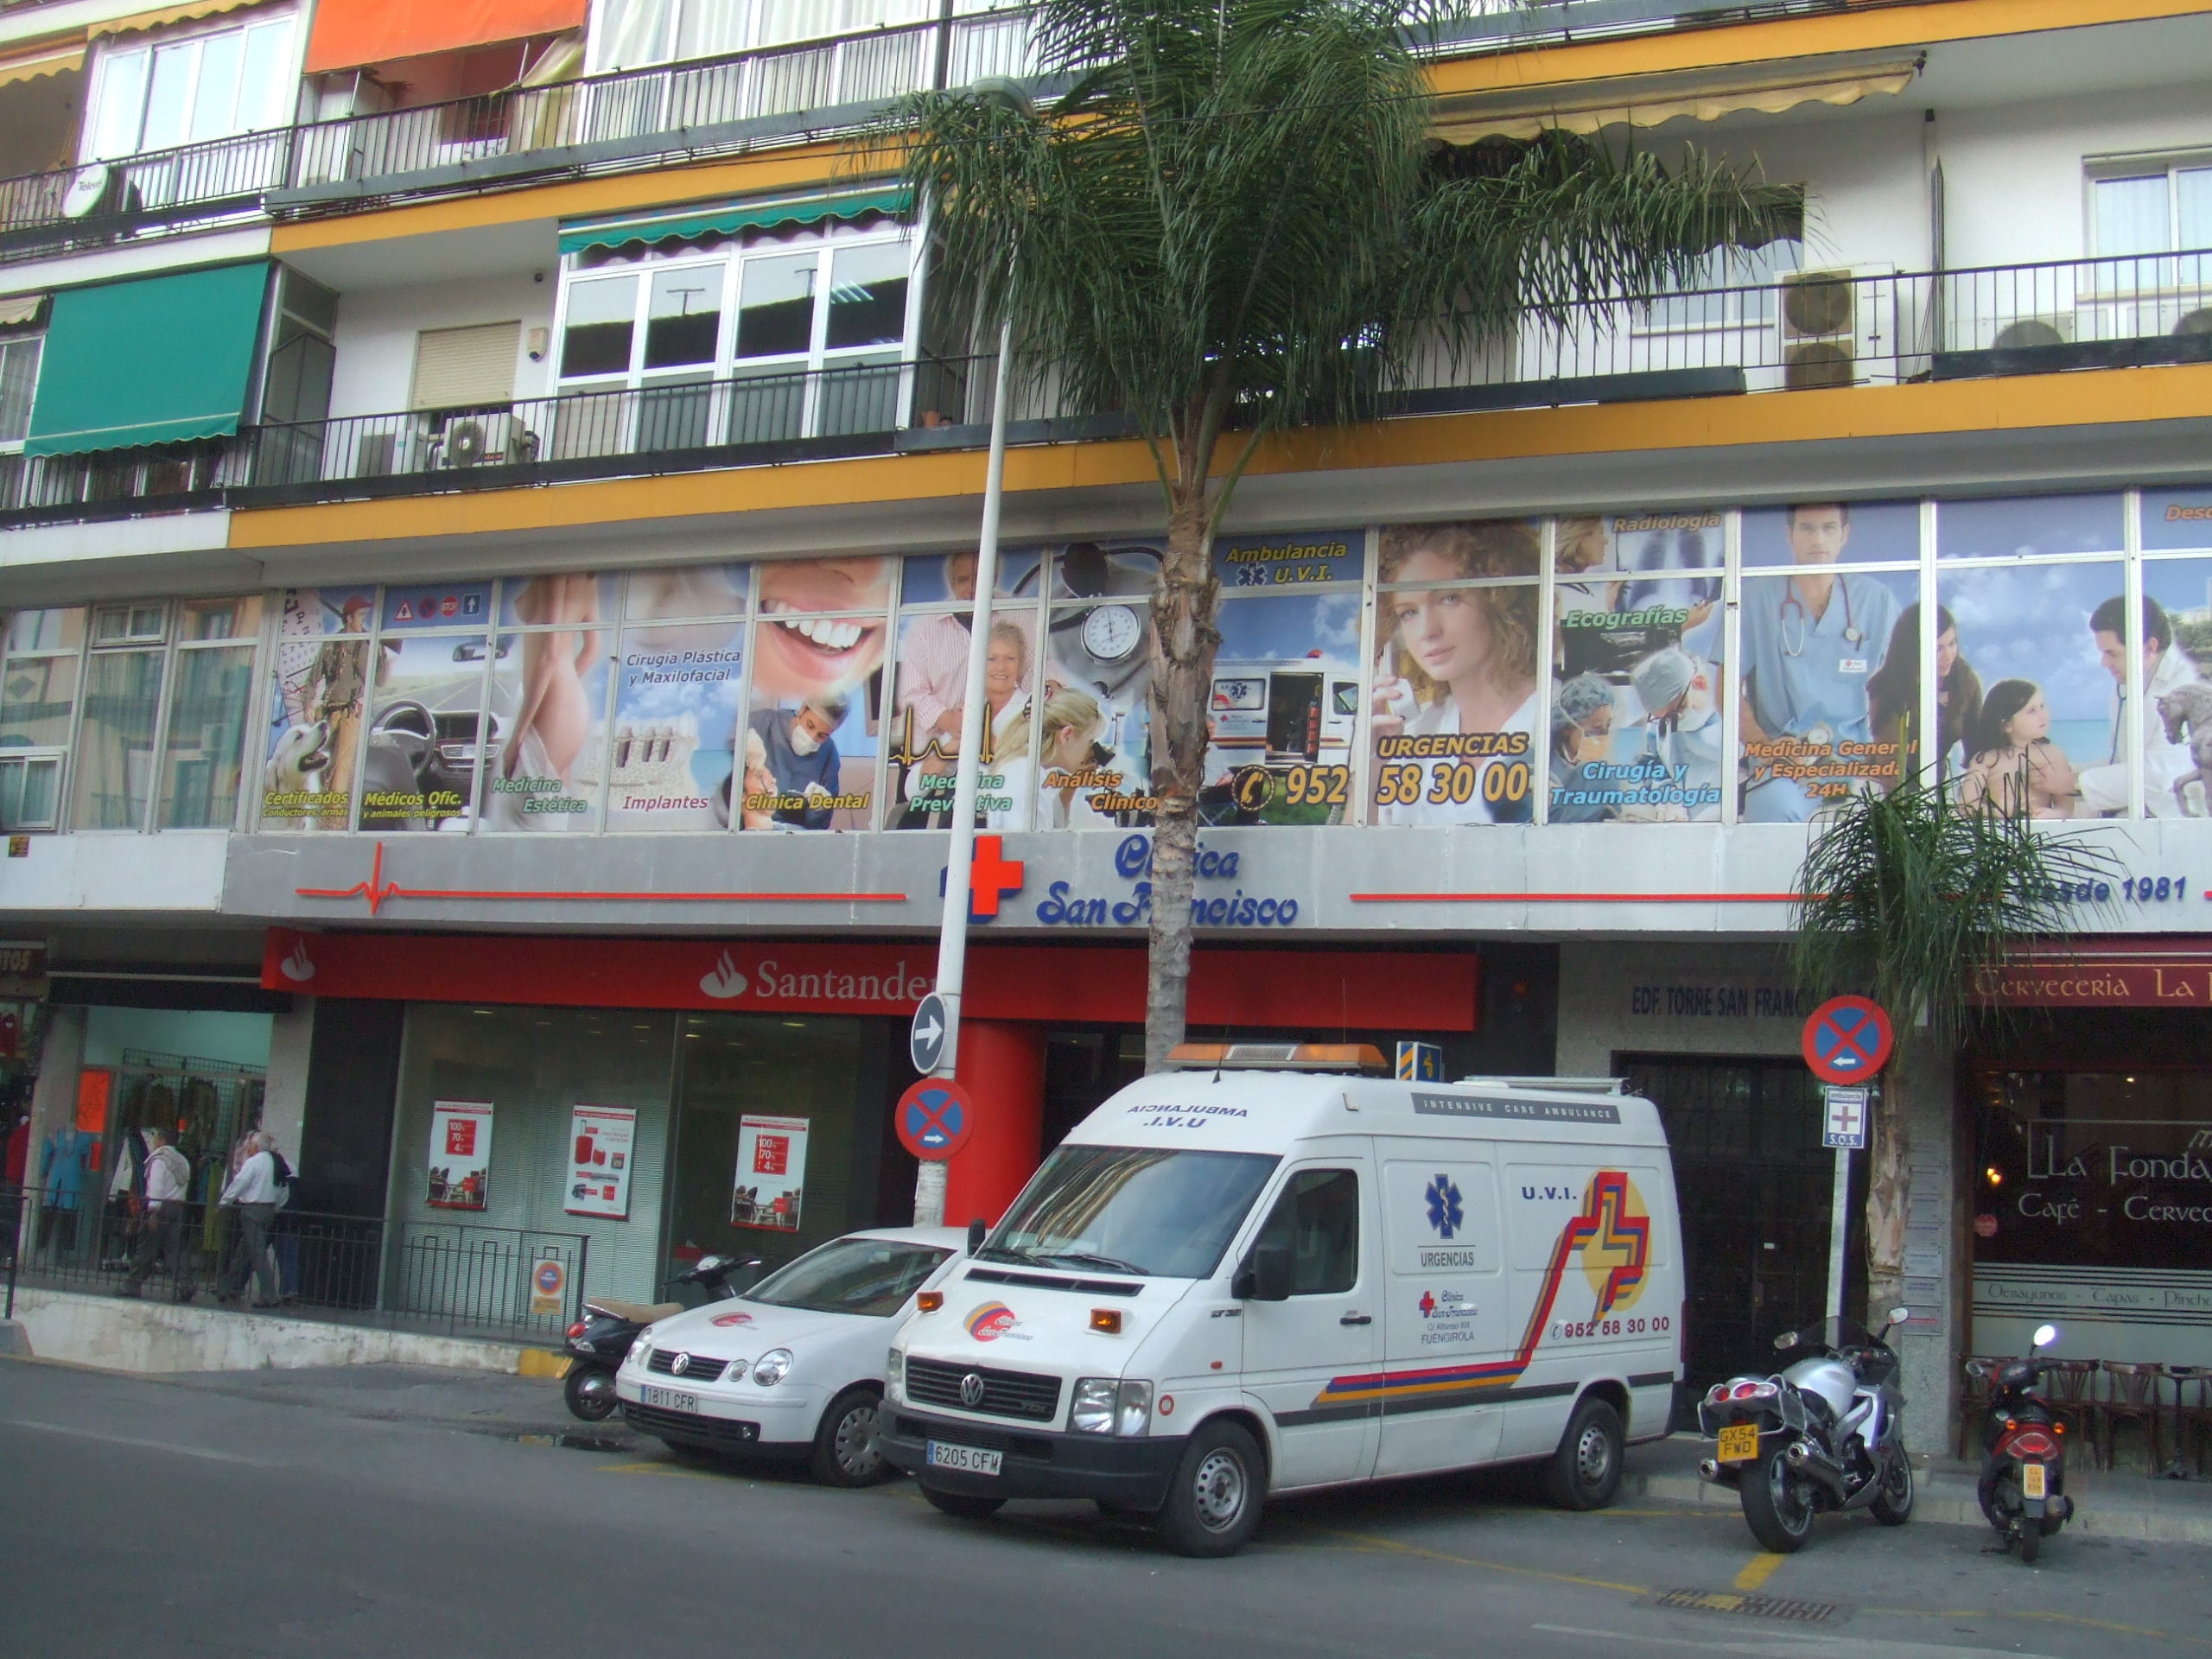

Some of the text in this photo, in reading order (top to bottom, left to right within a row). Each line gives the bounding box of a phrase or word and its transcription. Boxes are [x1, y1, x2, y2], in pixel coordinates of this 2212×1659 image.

[1612, 512, 1721, 532] Radiología
[1224, 542, 1347, 563] Ambulancia
[1274, 566, 1332, 583] U.V.I.
[1566, 605, 1688, 630] Ecografías
[683, 650, 741, 664] Plástica
[629, 669, 731, 687] y Maxilofacial
[1379, 734, 1529, 757] URGENCIAS
[1745, 739, 1918, 757] Medicina Generl
[1043, 770, 1122, 788] Análisis
[1582, 760, 1688, 782] Cirugía y
[1753, 766, 1765, 780] y
[492, 777, 563, 792] Medicina
[919, 772, 1005, 790] Medina
[1286, 762, 1529, 805] 952 58 30 00
[264, 791, 348, 805] Certificados
[364, 790, 462, 806] Médicos Ofic.
[1551, 783, 1720, 806] Traumatología
[1805, 783, 1848, 798] 24H
[523, 794, 588, 814] Estética
[622, 796, 709, 811] Implantes
[745, 792, 869, 810] Clínica Dental
[909, 795, 1014, 812] Prevtiva
[321, 808, 347, 817] armas
[371, 810, 410, 818] animales
[413, 808, 461, 819] peligrosos
[2122, 876, 2186, 902] 1981
[1037, 881, 1298, 925] San Fncisco
[756, 961, 938, 1001] Santande
[2154, 969, 2195, 996] La
[1667, 986, 1712, 1015] TORRE
[1717, 987, 1747, 1015] SAN
[1424, 1100, 1611, 1119] INTENSIVE CARE AMBULANCE
[1829, 1134, 1857, 1146] S.O.S.
[2046, 1135, 2212, 1185] La Fonda
[1522, 1186, 1577, 1200] U.V.I.
[1421, 1252, 1474, 1267] URGENCIAS
[1565, 1317, 1669, 1338] 952 58 30 00
[1421, 1332, 1474, 1344] FUENGIROLA
[648, 1389, 695, 1412] 1811 CFR
[1720, 1427, 1755, 1442] GX54
[935, 1446, 968, 1467] 6205
